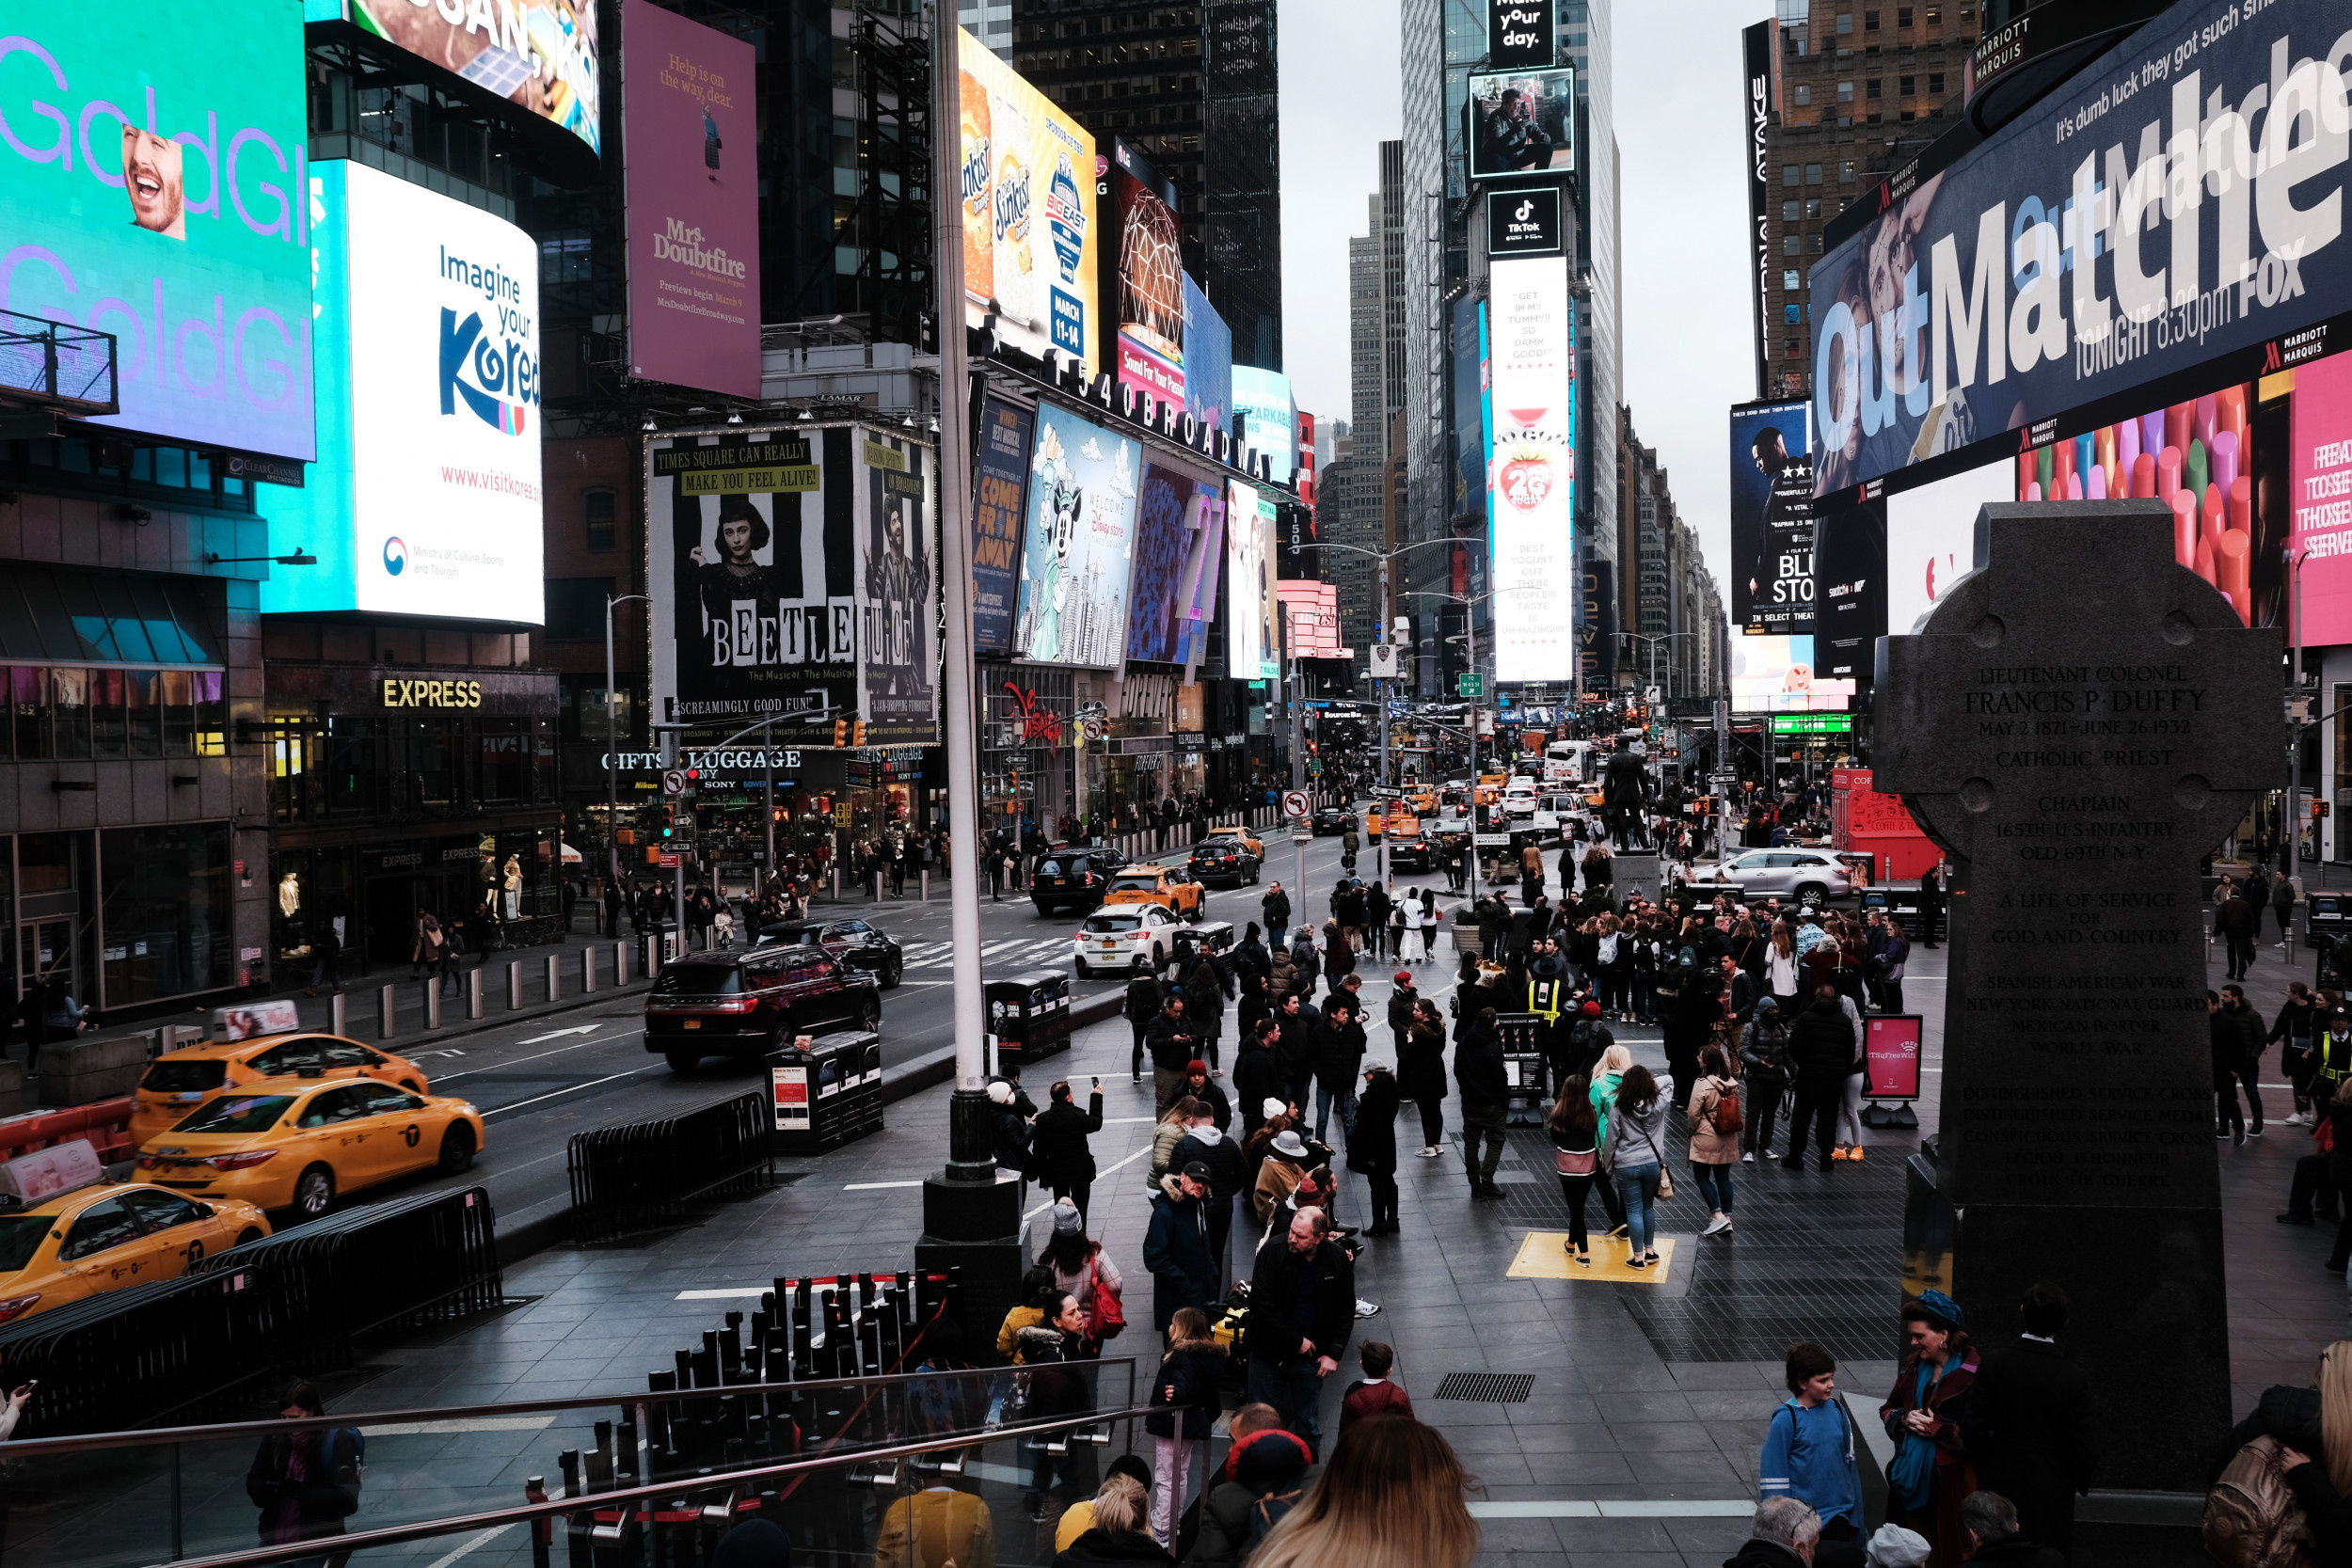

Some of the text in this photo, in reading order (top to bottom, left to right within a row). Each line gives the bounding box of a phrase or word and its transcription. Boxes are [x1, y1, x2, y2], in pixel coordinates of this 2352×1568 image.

[1500, 9, 1541, 30] your
[1502, 30, 1539, 48] day.
[1977, 18, 2029, 63] MARRIOTT
[669, 54, 725, 87] Help is on
[1976, 43, 2021, 83] MARQUIS
[660, 71, 679, 88] the
[2057, 4, 2238, 144] It's dumb luck they got such
[1891, 159, 1918, 186] MARRIOTT
[1891, 177, 1915, 200] MARQUIS
[1046, 195, 1086, 230] BIG EAST
[666, 216, 706, 245] Mrs.
[1507, 223, 1540, 233] TikTok
[653, 233, 746, 279] Doubtfire
[439, 244, 520, 305] Imagine
[660, 279, 692, 296] Previews
[693, 287, 713, 301] begin
[1055, 294, 1080, 323] MARCH
[497, 303, 531, 341] your
[2283, 325, 2328, 349] MARRIOTT
[2283, 341, 2322, 364] MARQUIS
[1124, 350, 1168, 392] Sound For Your
[2031, 419, 2058, 436] MARRIOTT
[2031, 430, 2055, 447] MARQUIS
[658, 442, 807, 470] TIMES SQUARE CAN REALLY
[686, 468, 816, 491] MAKE YOU FEEL ALIVE!
[981, 476, 1020, 513] COME
[1089, 492, 1125, 516] WELCOME
[413, 546, 441, 562] Ministry
[973, 535, 1015, 570] AWAY
[413, 563, 459, 578] and Tourism
[1753, 612, 1789, 622] IN SELECT
[749, 671, 763, 681] The
[804, 669, 820, 679] The
[1979, 666, 2187, 684] LIEUTENANT COLONEL
[383, 679, 482, 707] EXPRESS
[1964, 689, 2208, 715] FRANCIS DUFFY
[754, 698, 783, 712] GOOD
[1979, 720, 2191, 736] MAY 2 26 1932
[1995, 750, 2173, 768] CATHOLIC PRIEST
[2038, 796, 2131, 813] CHAPLAIN
[382, 853, 421, 868] EXPRESS
[442, 847, 479, 861] EXPRESS
[2020, 846, 2058, 861] OLD
[1999, 894, 2176, 908] A LIFE OF SERVICE
[2070, 912, 2101, 925] FOR
[1992, 929, 2183, 944] GOD AND COUNTRY
[2149, 976, 2187, 990] WAR
[1966, 998, 2207, 1011] NEW YORK NATIONAL GUARD
[2012, 1020, 2161, 1033] MEXICAN BORDER
[2031, 1041, 2142, 1054] WORLD WAR
